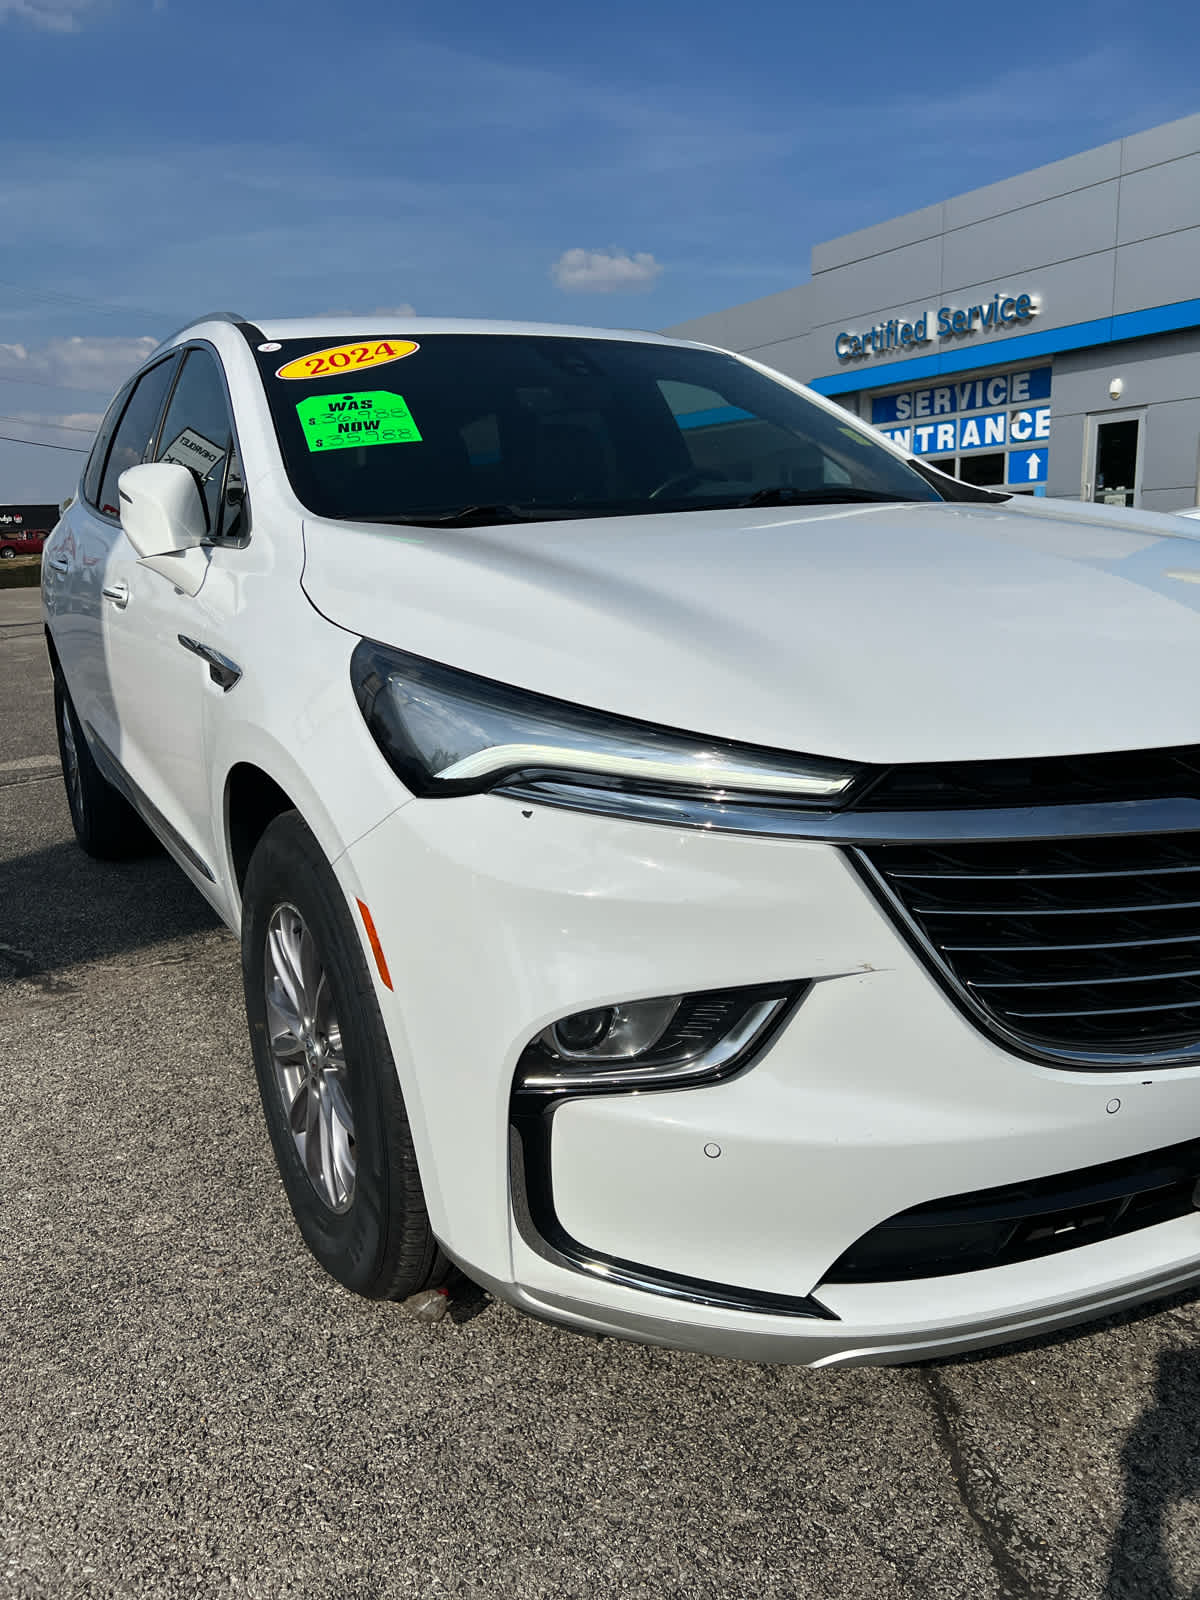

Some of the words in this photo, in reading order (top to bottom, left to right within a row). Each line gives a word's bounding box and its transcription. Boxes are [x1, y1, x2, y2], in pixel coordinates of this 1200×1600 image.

[835, 311, 928, 358] Certified
[936, 293, 1032, 336] Service
[305, 342, 399, 375] 2024
[328, 400, 373, 412] WAS
[895, 373, 1031, 420] SERVICE
[337, 419, 381, 433] NOW
